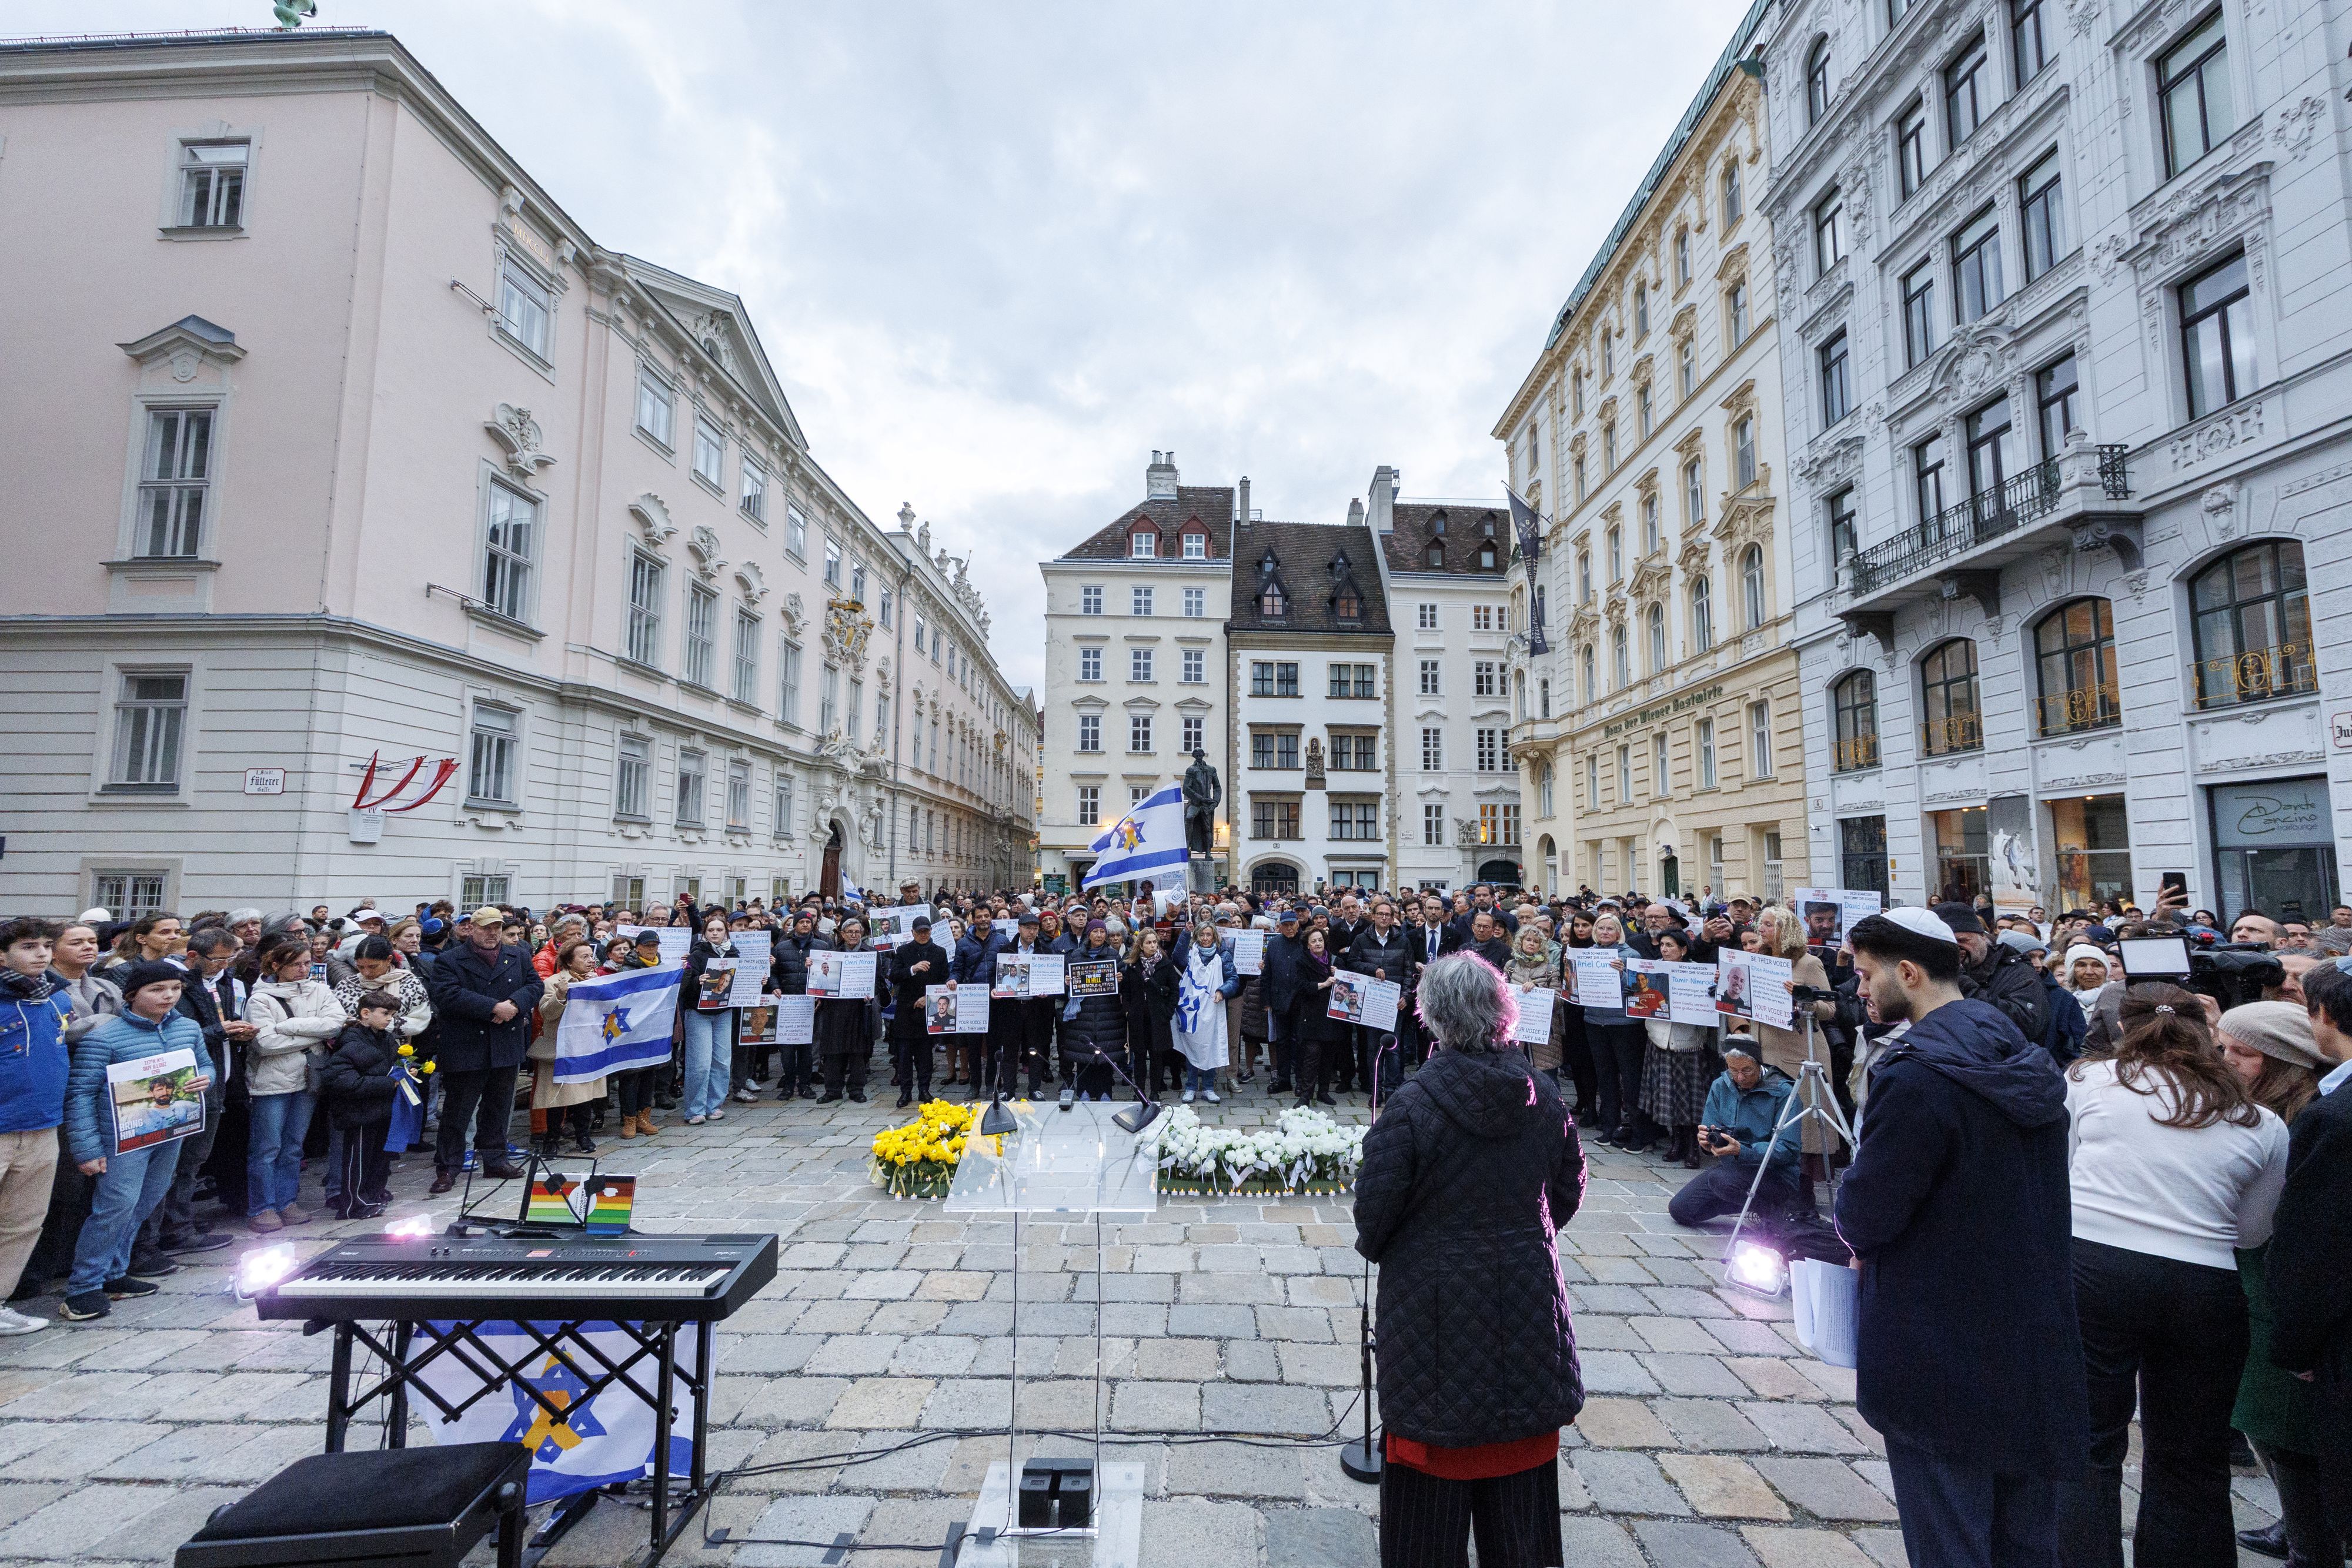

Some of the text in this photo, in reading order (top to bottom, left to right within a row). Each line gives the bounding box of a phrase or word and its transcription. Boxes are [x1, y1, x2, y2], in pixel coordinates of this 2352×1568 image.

[2234, 793, 2316, 818] Dante
[1768, 1007, 1783, 1015] VOICE
[1765, 1015, 1777, 1023] THEY
[119, 1118, 143, 1131] BRING
[120, 1129, 135, 1141] HIM
